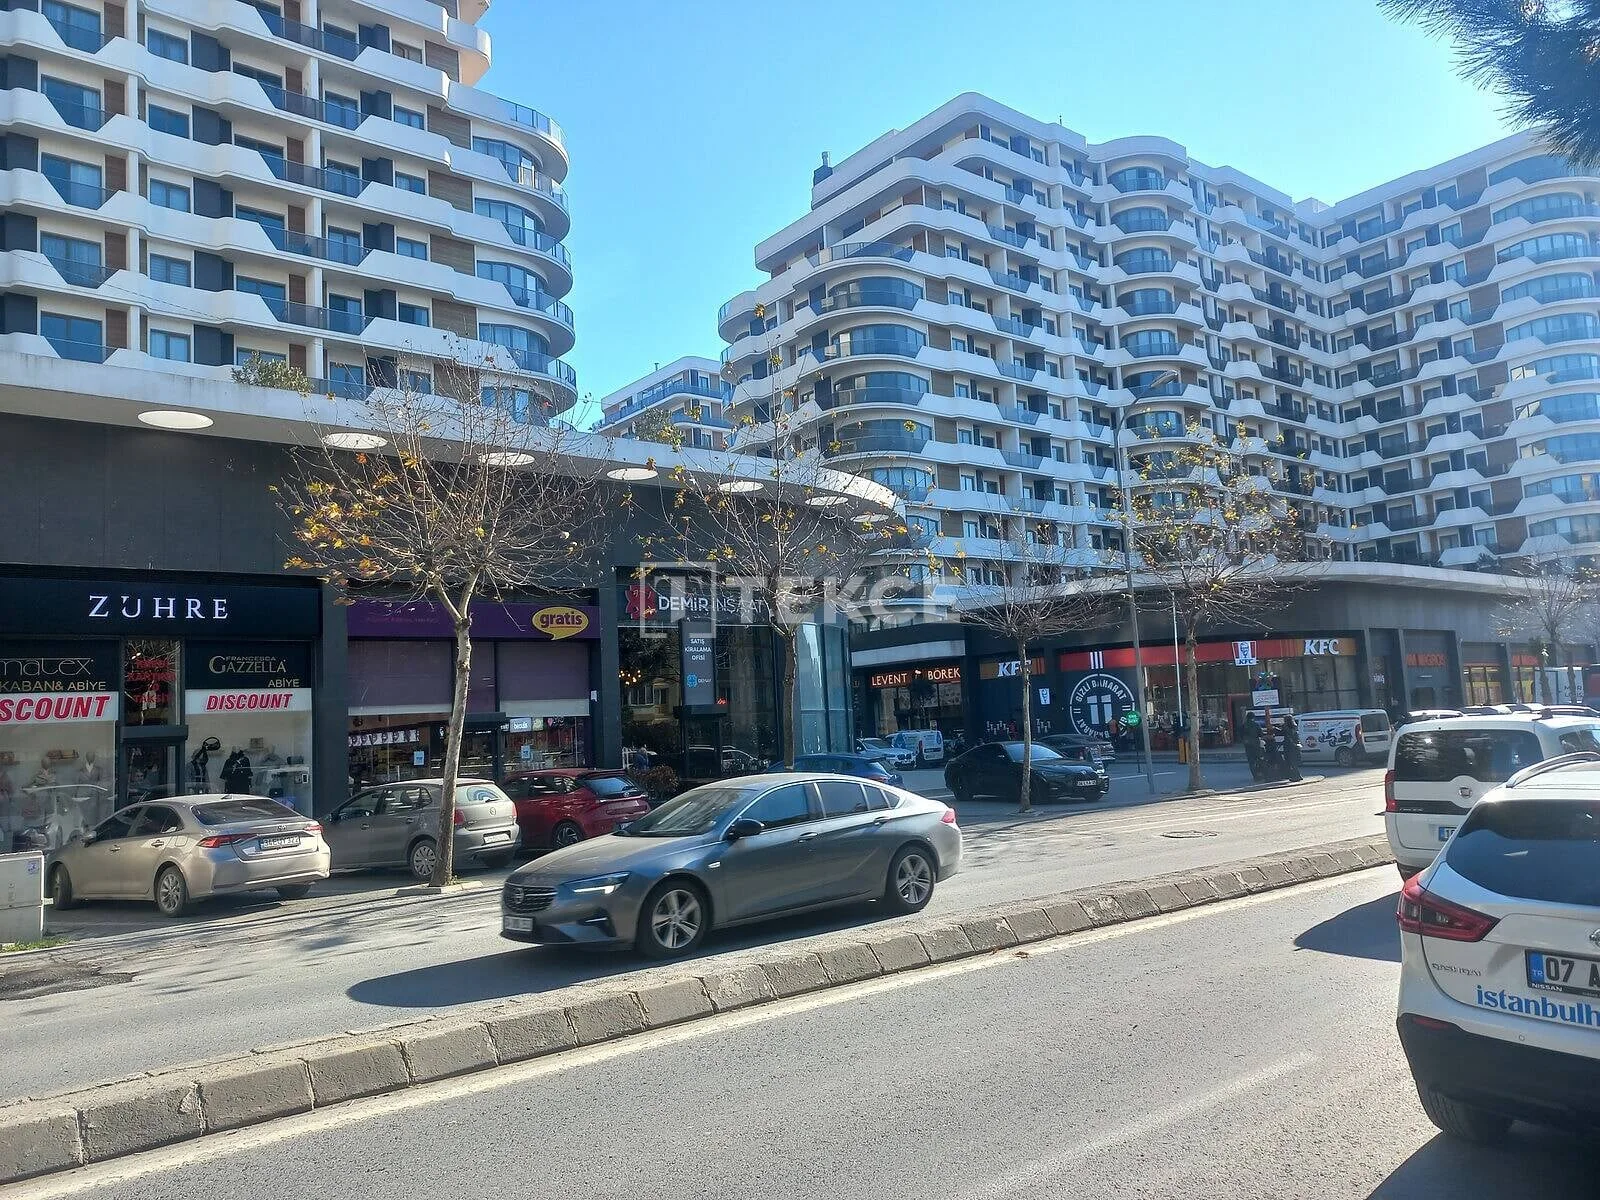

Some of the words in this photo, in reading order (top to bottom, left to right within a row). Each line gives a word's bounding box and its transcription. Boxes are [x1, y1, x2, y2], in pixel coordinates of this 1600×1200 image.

[540, 611, 583, 628] gratis
[1303, 639, 1340, 655] KFC
[208, 655, 287, 674] GAZZELLA
[267, 678, 300, 688] ABİYE
[872, 673, 908, 686] LEVENT
[927, 667, 961, 681] BÖREK
[67, 680, 107, 691] ABİYE
[1091, 679, 1127, 700] BAHARAT
[206, 693, 293, 710] DISCOUNT
[1532, 969, 1544, 977] TR
[1545, 956, 1575, 983] 07
[1531, 982, 1563, 992] NISSAN
